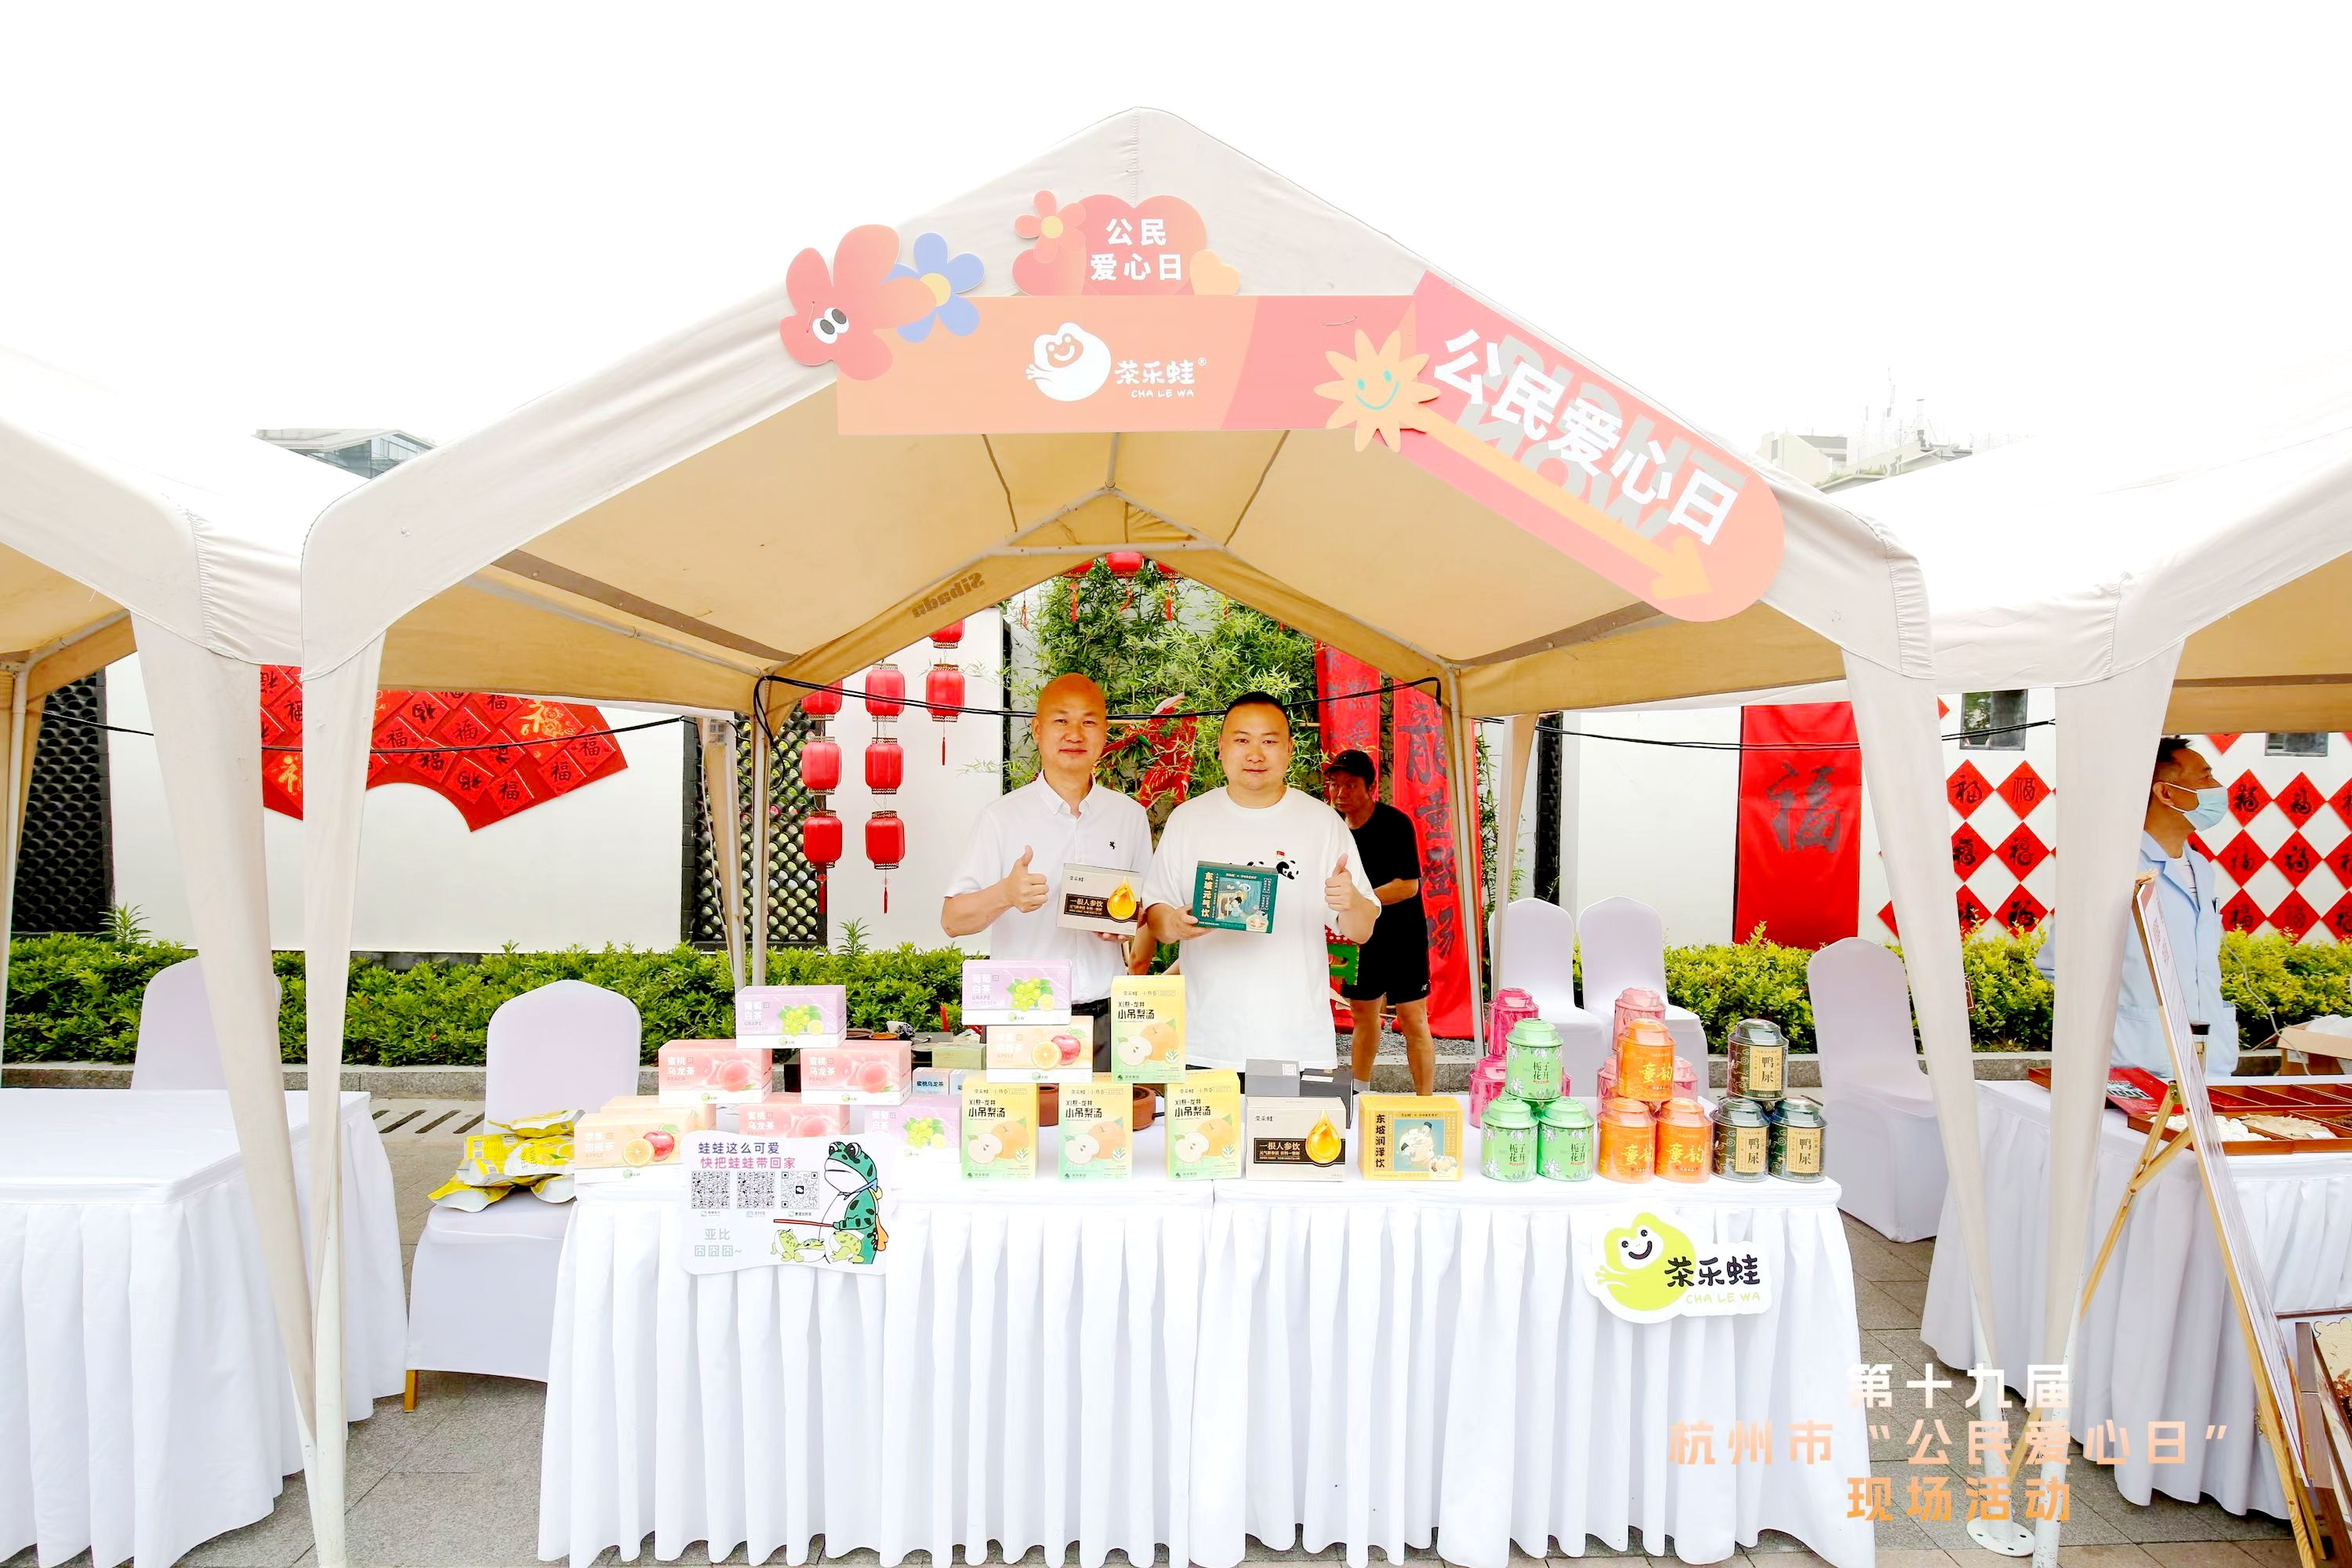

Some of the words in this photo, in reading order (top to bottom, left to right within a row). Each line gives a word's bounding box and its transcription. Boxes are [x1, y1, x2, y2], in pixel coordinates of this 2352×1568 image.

[1105, 217, 1167, 247] 公民
[1090, 252, 1182, 281] 爱心日
[1131, 389, 1154, 398] CHA
[1157, 389, 1173, 398] LE
[1177, 388, 1195, 397] WA
[1434, 328, 1739, 546] 公民爱心日
[387, 728, 408, 749] 福
[580, 738, 601, 757] 福
[550, 763, 572, 782] 福
[498, 781, 521, 801] 福
[1766, 761, 1840, 853] 福
[972, 985, 991, 994] 白茶
[744, 1011, 763, 1020] 白茶
[1118, 1009, 1155, 1019] 小吊梨汤
[668, 1056, 686, 1065] 蜜桃
[809, 1056, 827, 1065] 蜜桃
[668, 1067, 695, 1076] 乌龙茶
[809, 1067, 836, 1076] 乌龙茶
[1762, 1056, 1774, 1083] 鸭屎
[747, 1110, 766, 1120] 蜜桃
[968, 1107, 1006, 1118] 小吊梨汤
[1065, 1108, 1102, 1118] 小吊梨汤
[1174, 1106, 1211, 1117] 小吊梨汤
[747, 1121, 775, 1131] 乌龙茶
[872, 1121, 889, 1131] 白茶
[1259, 1142, 1301, 1151] 一根人参饮
[1375, 1113, 1386, 1168] 东坡润泽饮
[698, 1142, 779, 1155] 蛙蛙这么可爱
[1748, 1138, 1760, 1165] 鸭屎
[1798, 1138, 1812, 1165] 鸭屎
[700, 1156, 797, 1169] 快把蛙蛙带回家
[704, 1229, 731, 1240] 亚比
[1664, 1254, 1760, 1287] 茶乐蛙
[1686, 1294, 1712, 1305] CHA
[1718, 1292, 1735, 1303] LE
[1740, 1291, 1761, 1302] WA
